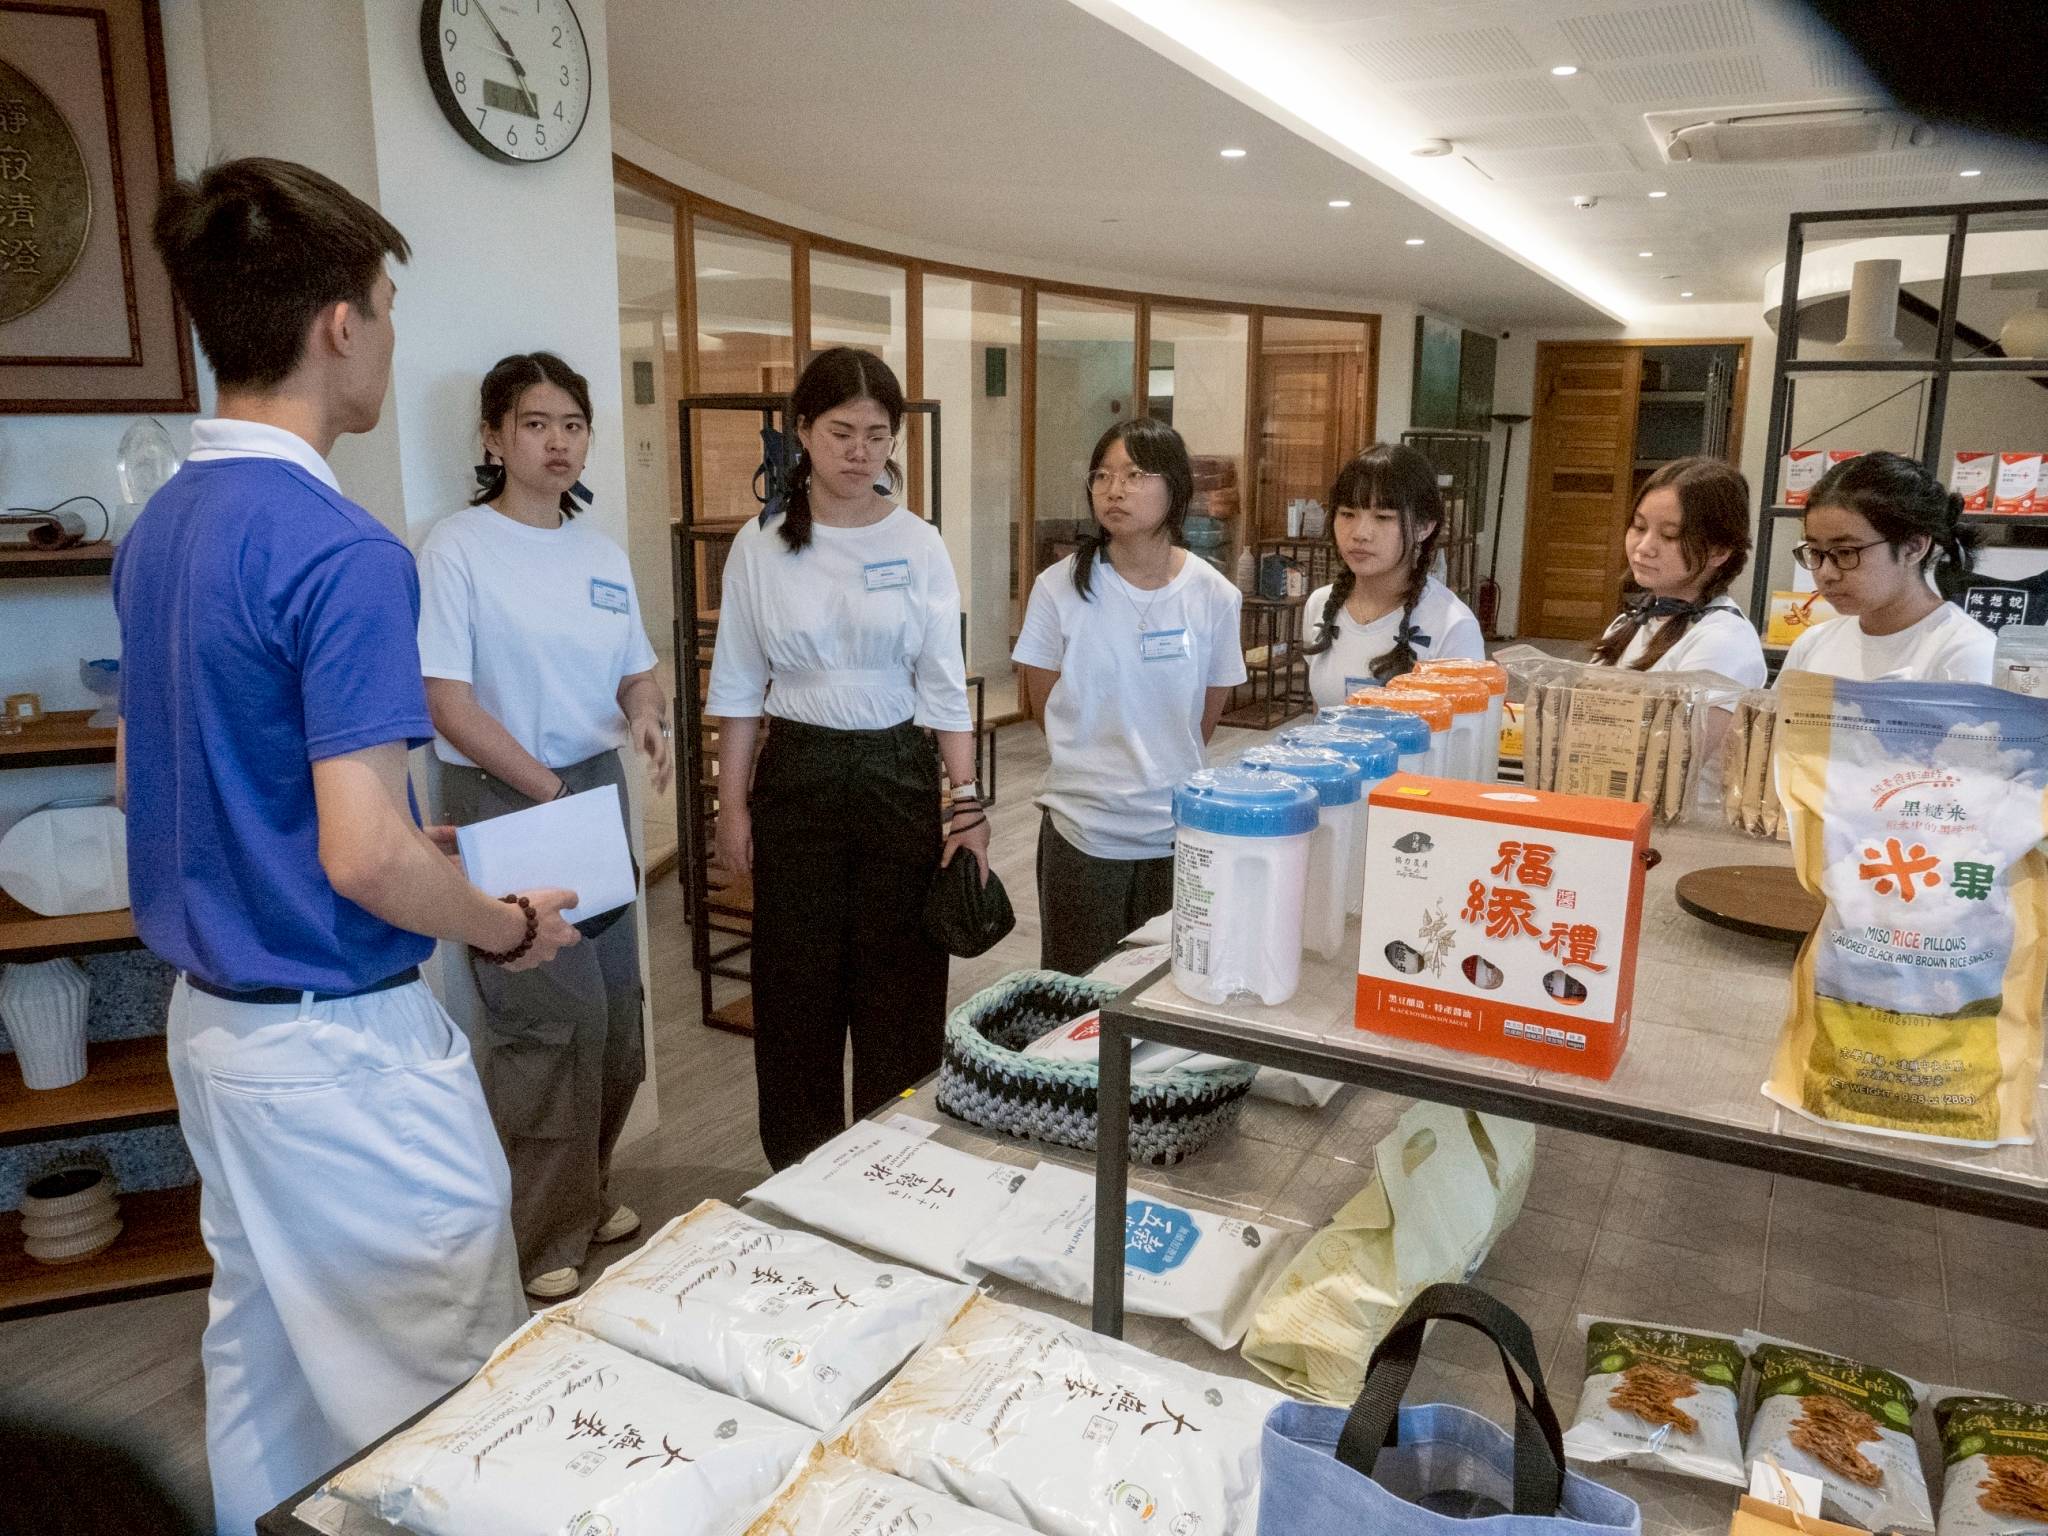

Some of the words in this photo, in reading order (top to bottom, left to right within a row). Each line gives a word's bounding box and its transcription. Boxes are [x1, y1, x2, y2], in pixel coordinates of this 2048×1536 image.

[445, 29, 457, 52] 9
[551, 26, 562, 48] 2
[455, 72, 467, 94] 8
[559, 65, 570, 87] 3
[476, 107, 488, 129] 7
[553, 100, 563, 121] 4
[506, 125, 518, 146] 6
[535, 124, 546, 145] 5
[1899, 800, 1967, 822] 黑糙米
[1864, 925, 1890, 944] MISO
[1892, 929, 1921, 949] RICE
[1923, 936, 1967, 952] PILLOWS
[1867, 946, 1895, 963] BLACK
[1895, 953, 1914, 965] AND
[1914, 955, 1948, 969] BROWN
[1949, 956, 1967, 969] RICE
[1967, 949, 1994, 966] SNACKS
[1848, 1082, 1892, 1098] WEIGHT
[1940, 1093, 1977, 1106] (280g)
[523, 1379, 553, 1402] WEIGHT
